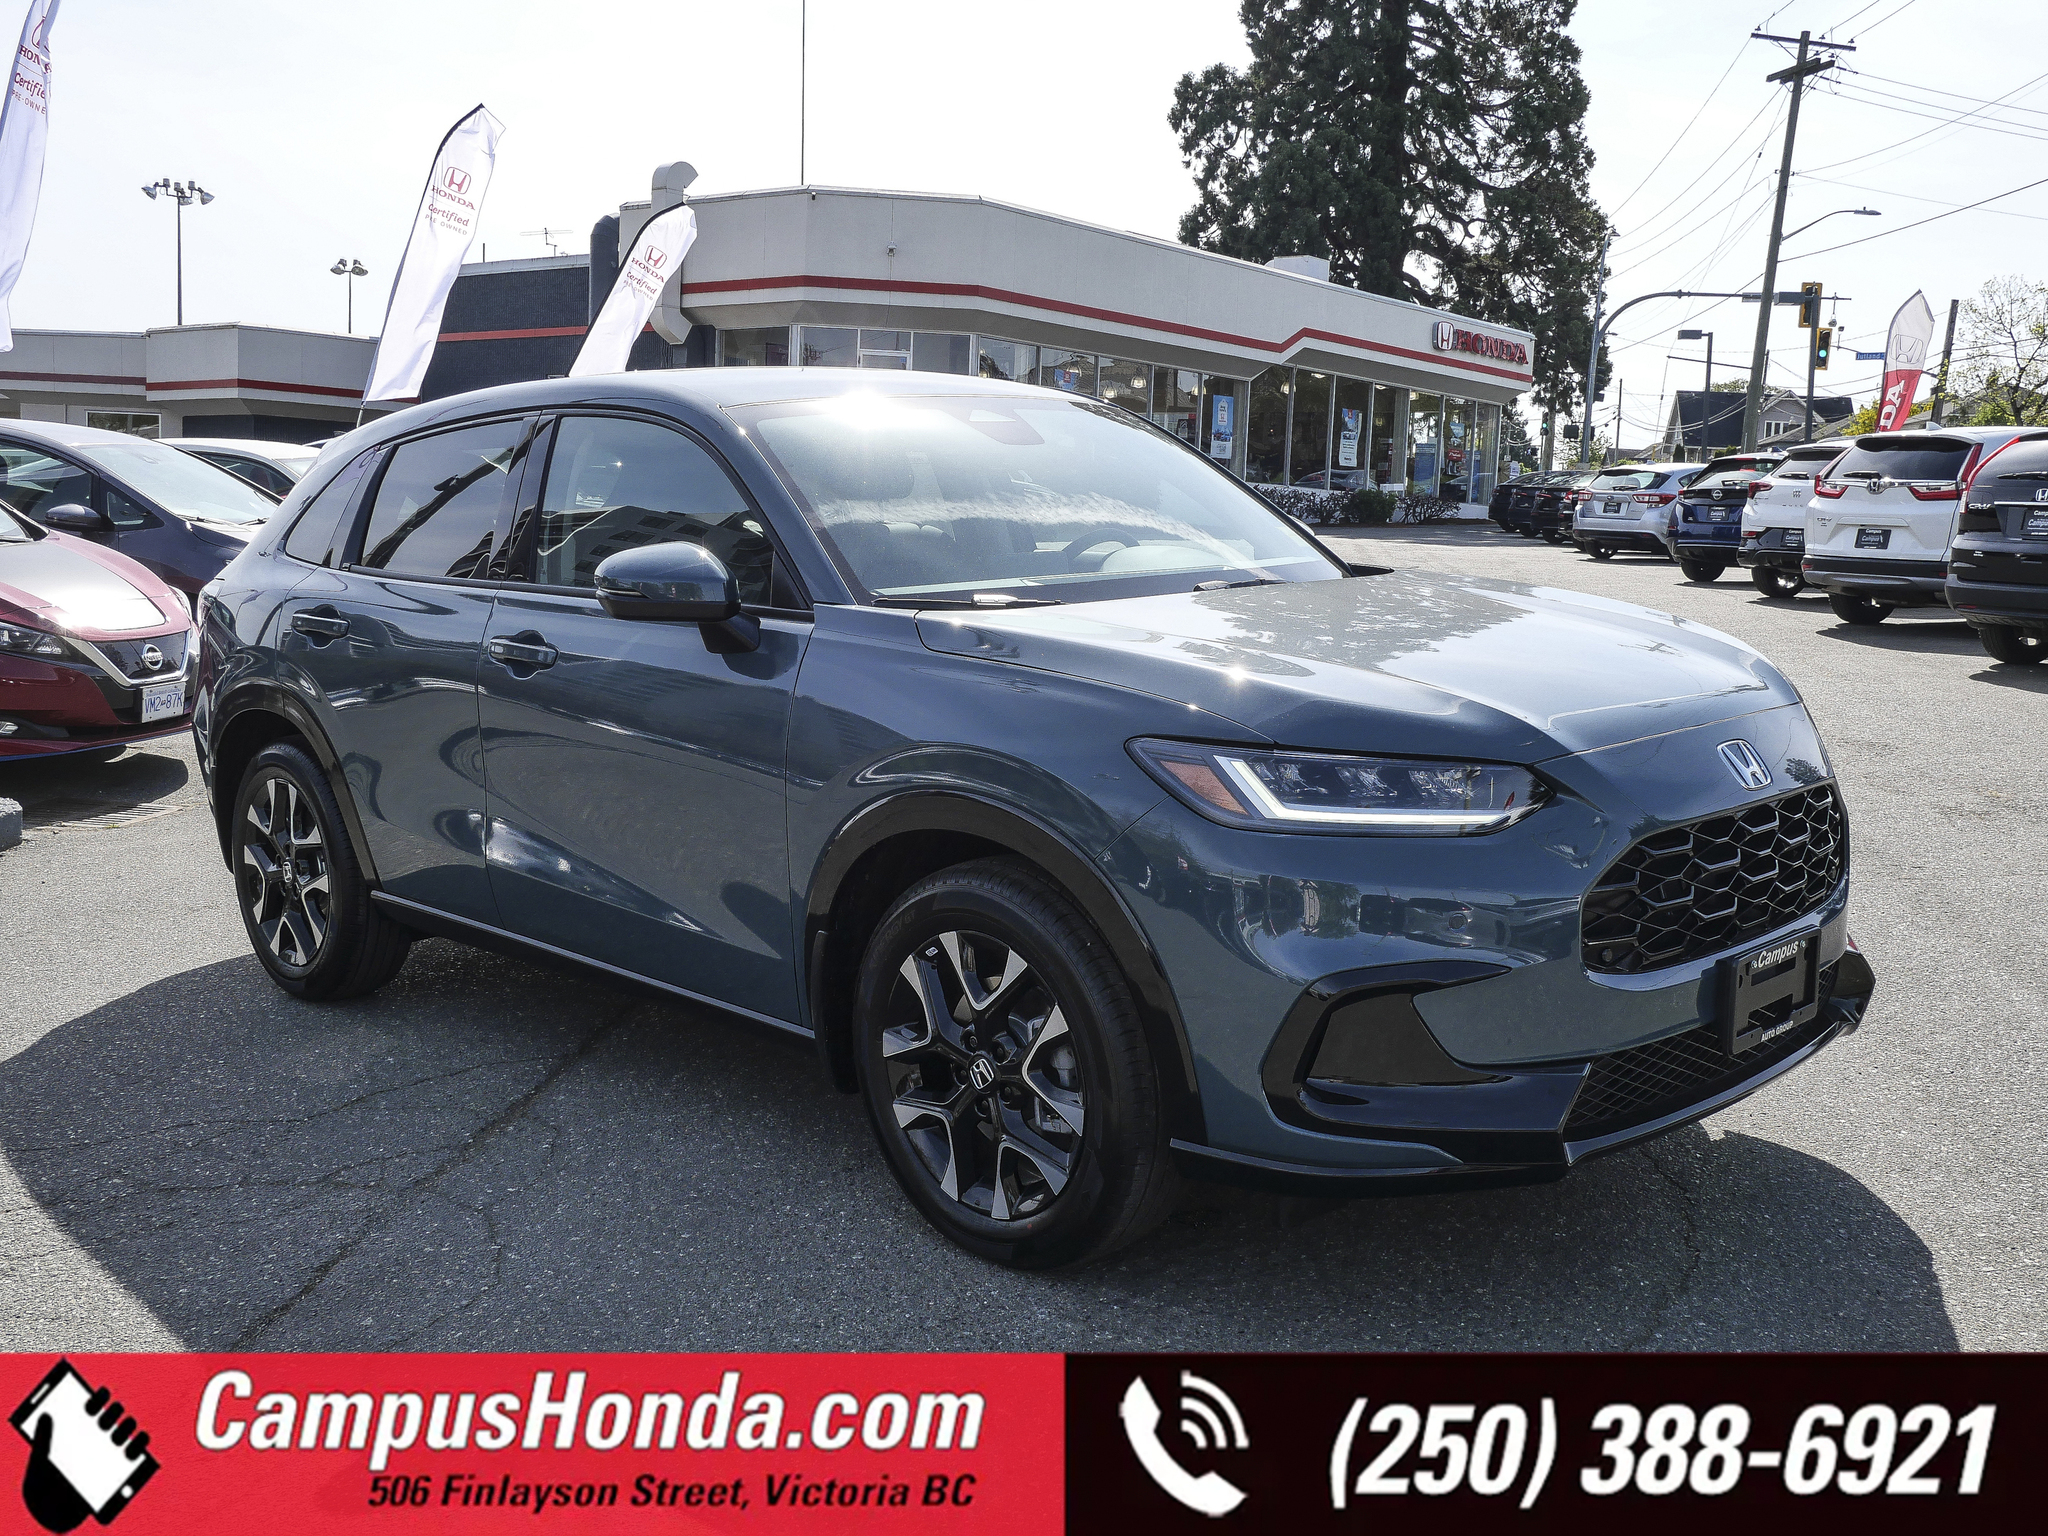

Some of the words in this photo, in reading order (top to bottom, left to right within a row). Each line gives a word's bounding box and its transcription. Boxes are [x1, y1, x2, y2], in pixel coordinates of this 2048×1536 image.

[19, 44, 52, 74] HONA
[14, 72, 47, 99] Certifie
[12, 88, 47, 114] PRE-OWNE
[431, 184, 476, 211] HONDA
[428, 203, 470, 227] Certified
[626, 271, 658, 294] Certified
[631, 257, 665, 283] HONDA
[1455, 328, 1529, 365] HONDA
[2034, 510, 2048, 518] Camp
[1758, 941, 1799, 968] Campus
[1761, 1029, 1776, 1042] AUTO
[1776, 1020, 1794, 1035] GROUP
